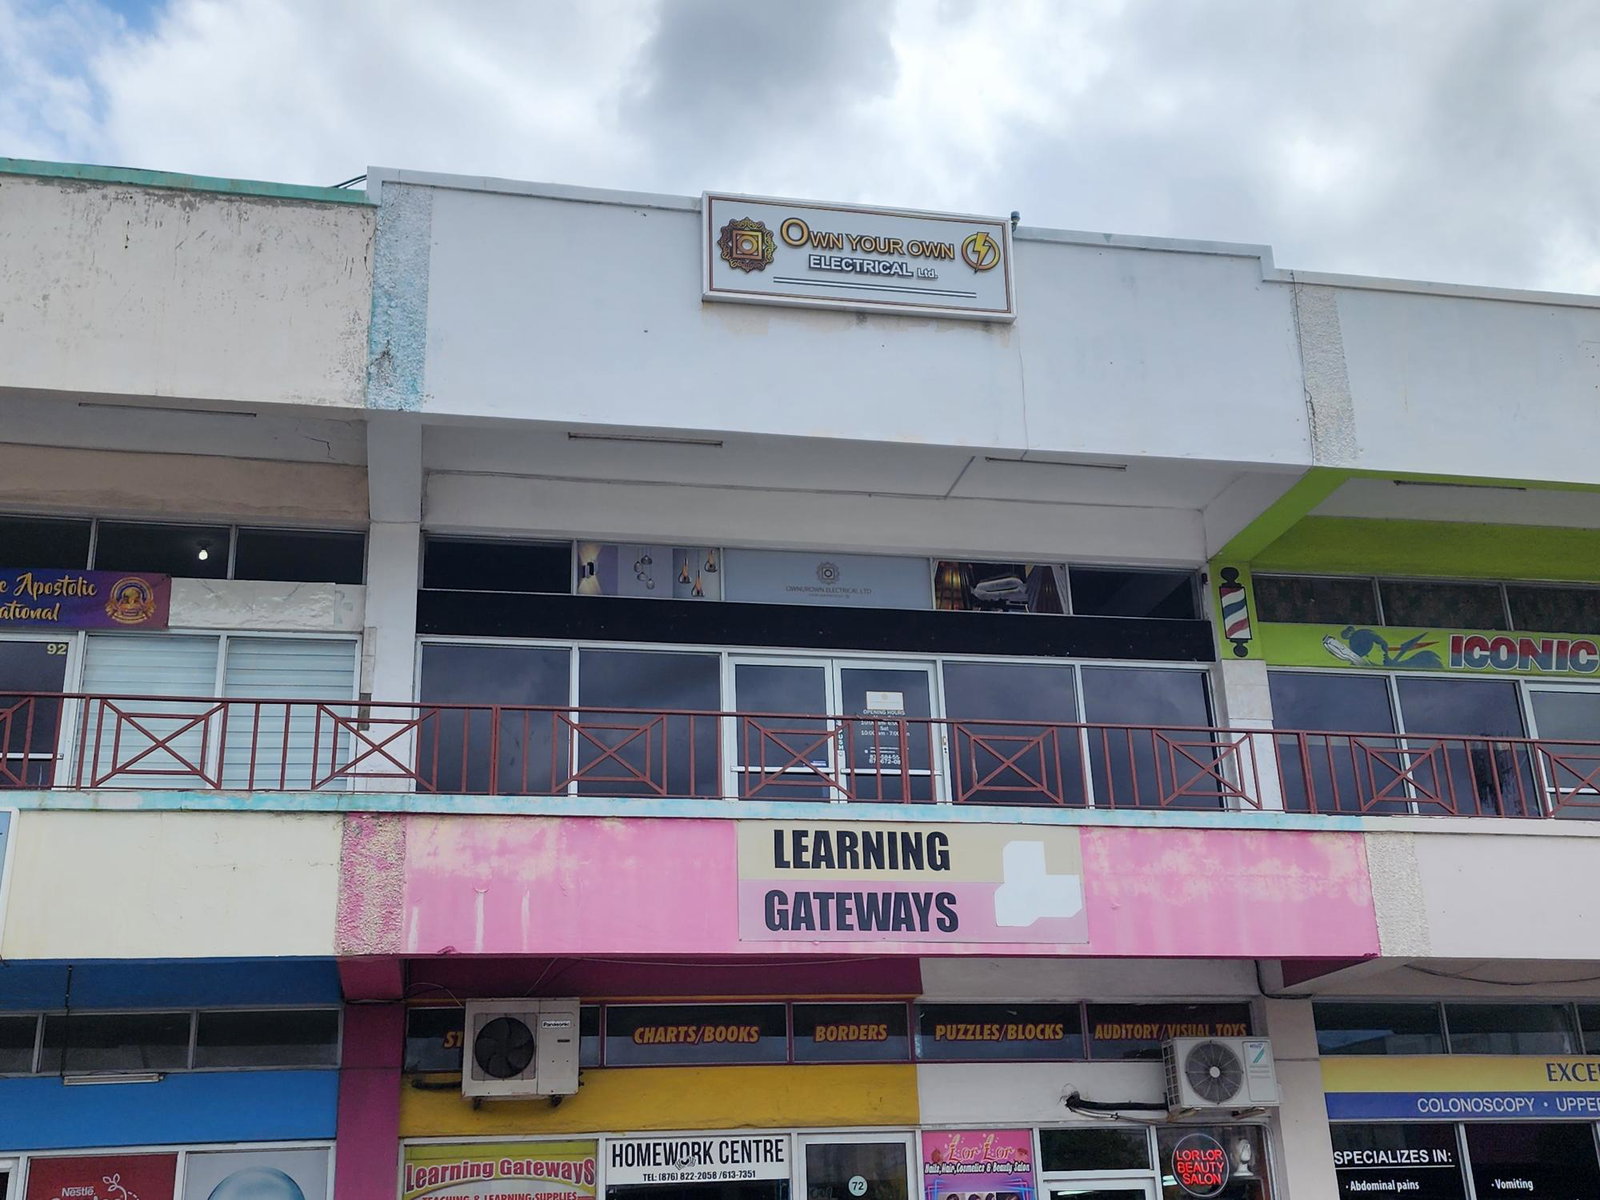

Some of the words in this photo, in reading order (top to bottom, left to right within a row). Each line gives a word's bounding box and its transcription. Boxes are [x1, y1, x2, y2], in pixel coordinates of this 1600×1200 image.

[846, 234, 906, 255] YOUR
[907, 239, 956, 259] OWN
[808, 253, 914, 277] ELECTRICAL
[917, 267, 939, 279] Ltd.
[13, 572, 97, 600] Apostolic
[47, 643, 67, 655] 92
[1449, 633, 1600, 674] ICONIC
[773, 828, 951, 872] LEARNING
[764, 889, 960, 933] GATEWAYS
[632, 1025, 760, 1044] CHARTS/BOOKS
[814, 1024, 888, 1042] BORDERS
[935, 1023, 1064, 1041] PUZZLES/BLOCKS
[1215, 1023, 1247, 1037] TOYS
[1546, 1063, 1600, 1082] EXCE
[1417, 1097, 1535, 1113] COLONOSCOPY
[612, 1141, 714, 1168] HOMEWORK
[719, 1139, 784, 1164] CENTRE
[1334, 1149, 1429, 1165] SPECIALIZES
[1433, 1149, 1452, 1163] IN:
[405, 1160, 495, 1193] Learning
[643, 1173, 657, 1181] TEL:
[658, 1172, 678, 1181] (876)
[680, 1171, 717, 1180] 822-2058
[1177, 1161, 1224, 1174] BEAUTY
[852, 1182, 864, 1190] 72
[1183, 1173, 1221, 1185] SALON
[1350, 1180, 1395, 1191] Abdominal
[1397, 1179, 1420, 1193] pains
[1494, 1178, 1534, 1191] Vomiting
